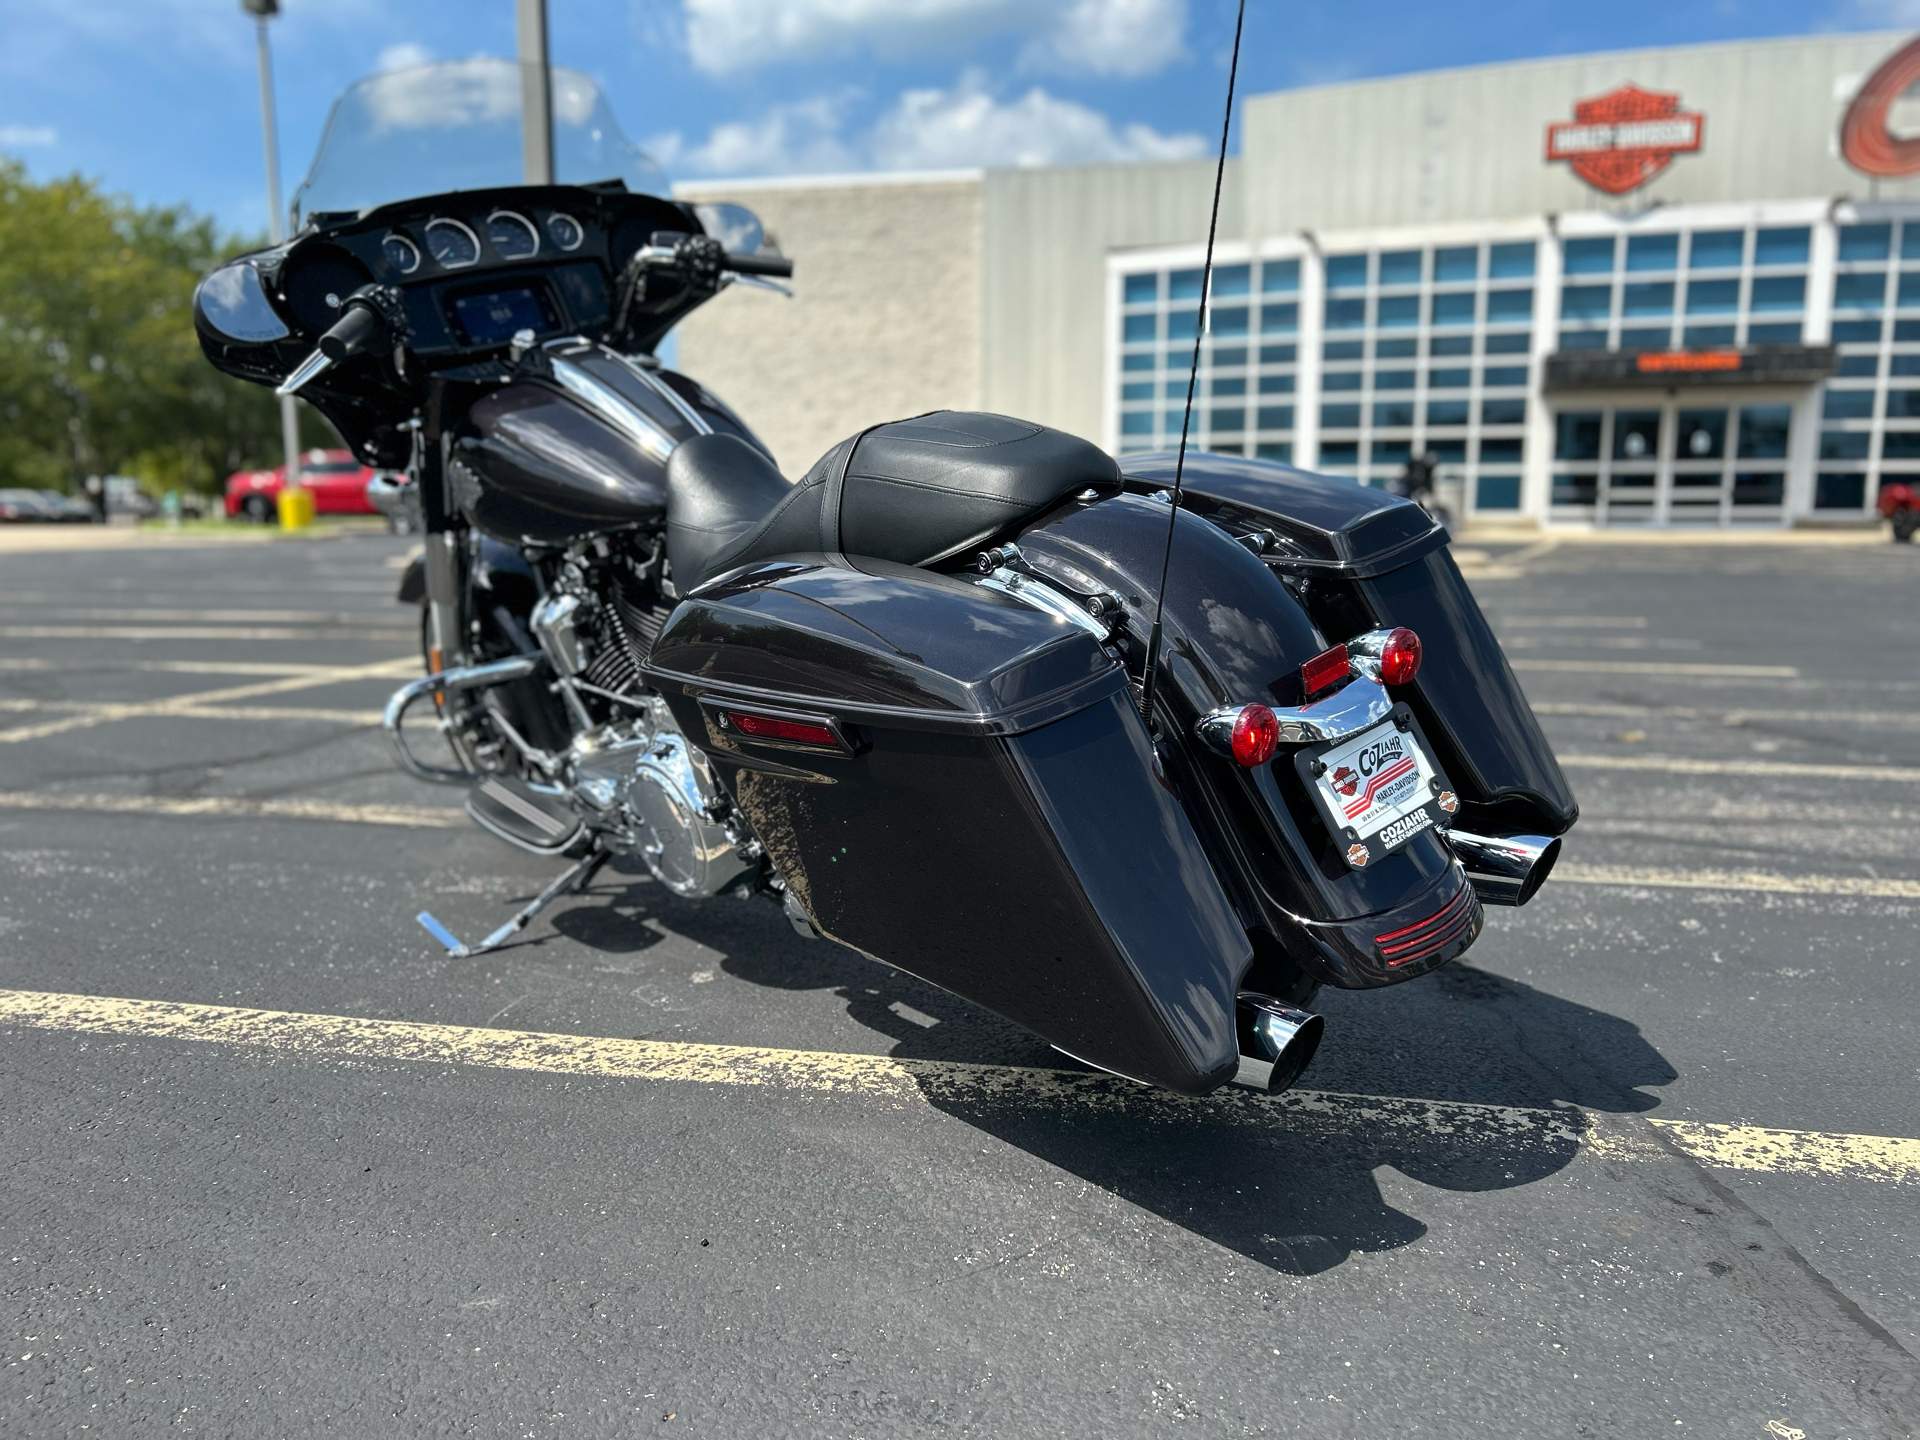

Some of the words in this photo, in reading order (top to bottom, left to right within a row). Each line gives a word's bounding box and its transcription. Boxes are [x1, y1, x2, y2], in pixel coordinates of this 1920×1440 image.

[1375, 769, 1421, 803] HARLEY-DAVIDSON
[1379, 807, 1430, 843] COZIAHR
[1384, 818, 1433, 850] HARLEY-DAVIDSON
